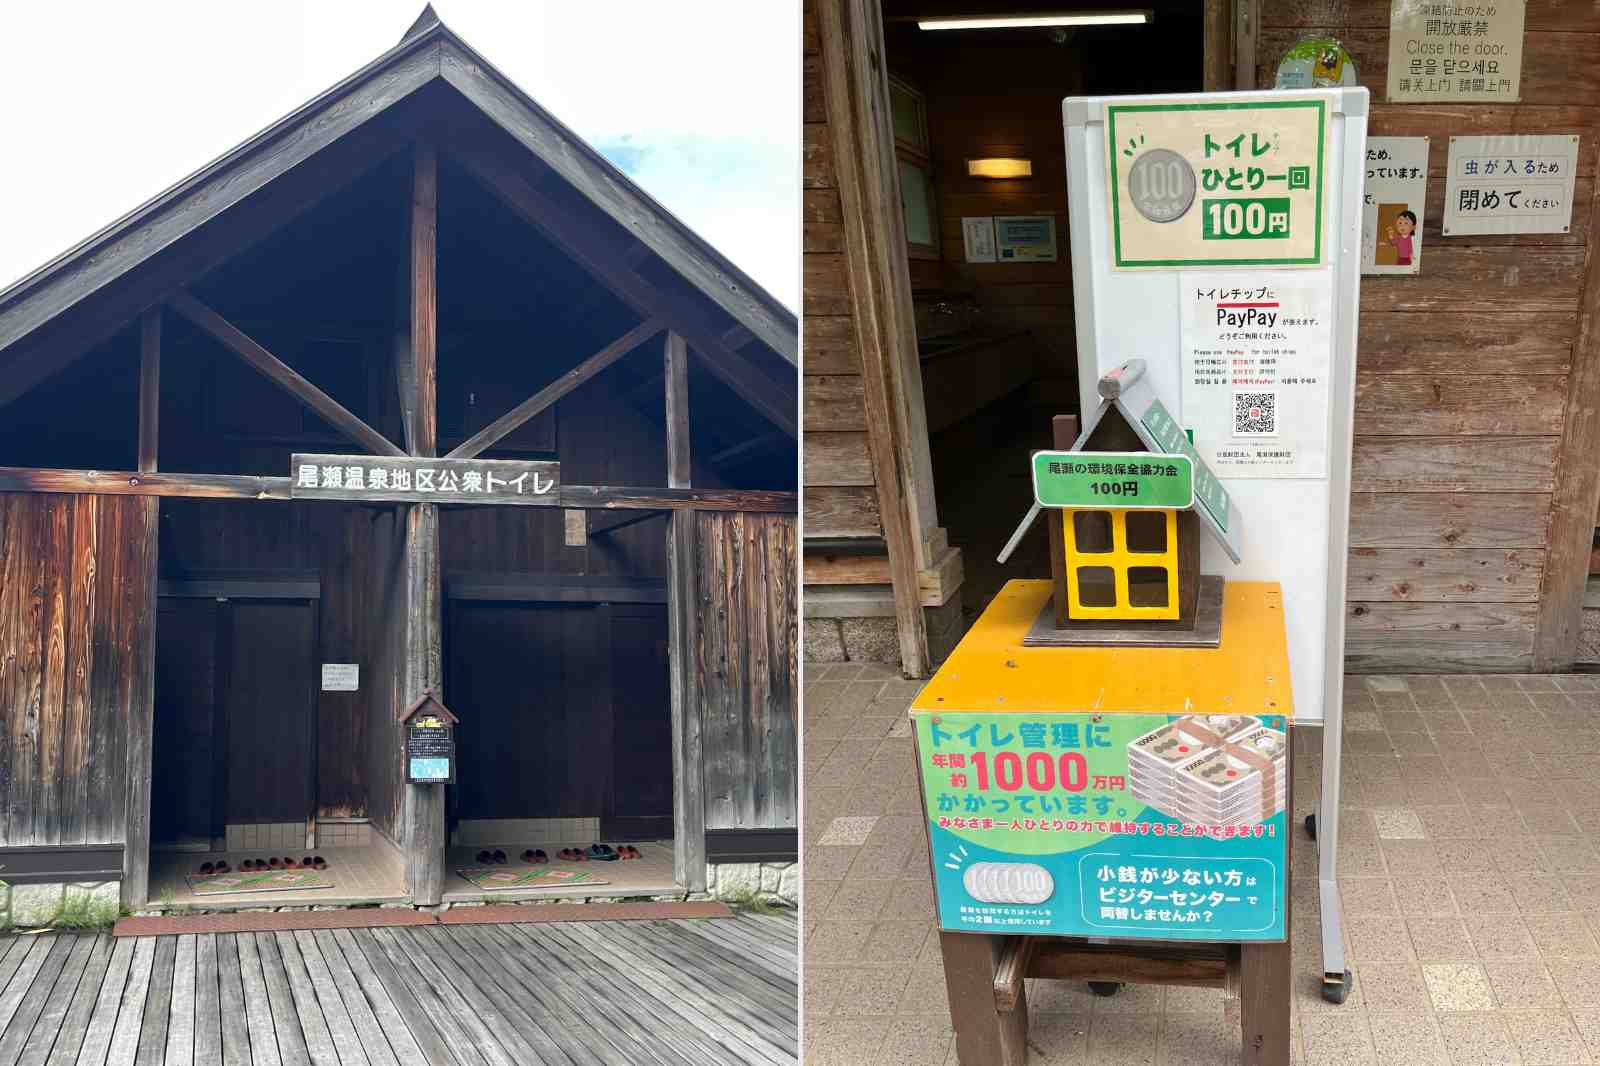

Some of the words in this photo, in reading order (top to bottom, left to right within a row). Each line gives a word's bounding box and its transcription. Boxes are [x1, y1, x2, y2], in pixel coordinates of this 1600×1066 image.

[1424, 19, 1489, 37] 開放厳禁
[1406, 39, 1445, 55] Close
[1449, 40, 1470, 55] the
[1474, 40, 1509, 56] door.
[1408, 58, 1439, 75] 문을
[1443, 58, 1500, 75] 닫으세요
[1204, 132, 1271, 158] トイレ
[1464, 159, 1560, 175] 虫が入るため
[1202, 165, 1311, 191] ひとり一回
[1459, 189, 1560, 212] 閉めてください
[1209, 202, 1289, 236] 100円
[1197, 286, 1275, 300] トイレチップに
[1216, 308, 1278, 329] PayPay
[297, 464, 554, 495] 尾瀬温泉地区公衆トイレ
[1048, 462, 1178, 477] 尾瀬の環境保全協力金
[1090, 481, 1138, 496] 100円
[931, 722, 1113, 749] トイレ管理に
[937, 793, 1127, 817] かかっています。
